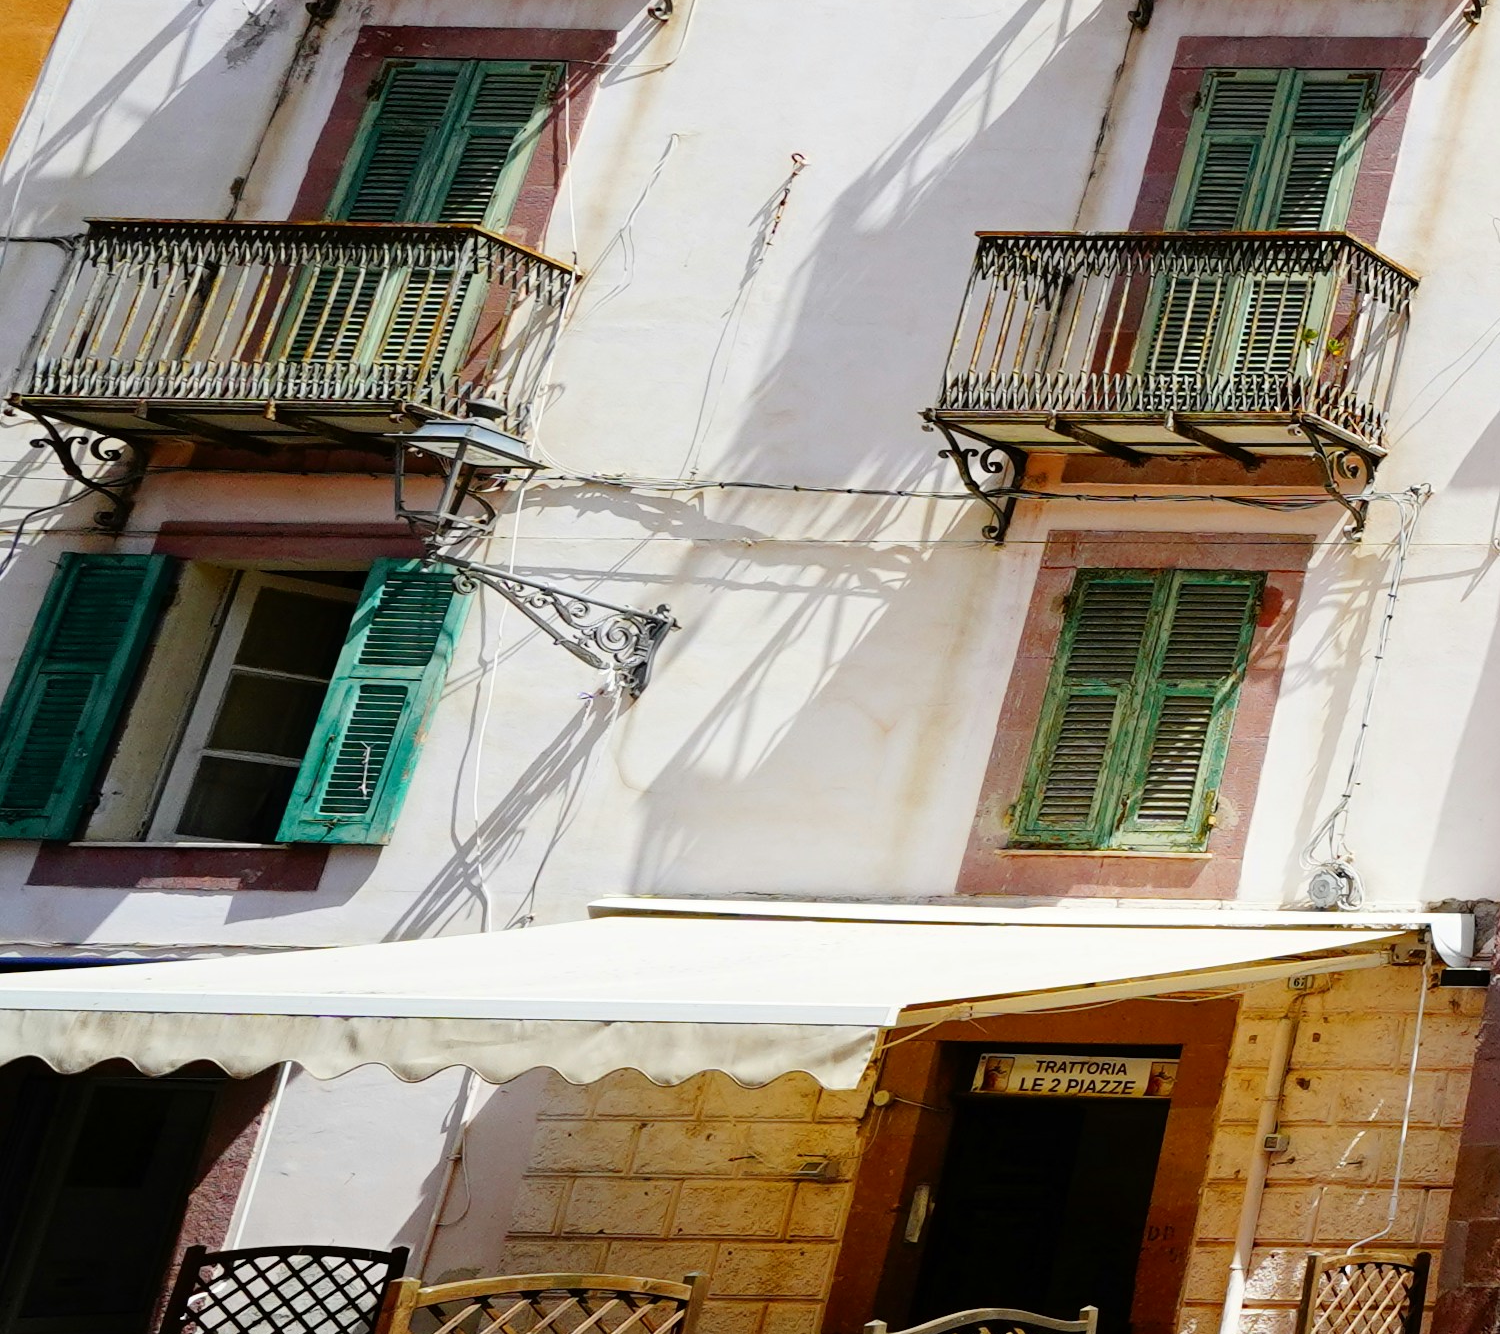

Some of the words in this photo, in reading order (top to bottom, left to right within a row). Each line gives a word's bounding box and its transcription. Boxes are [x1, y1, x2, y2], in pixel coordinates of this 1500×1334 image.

[1293, 977, 1306, 987] 67
[1035, 1060, 1128, 1076] TRATTORIA
[1018, 1077, 1046, 1092] LE
[1048, 1078, 1061, 1093] 2
[1064, 1078, 1136, 1095] PIAZZE
